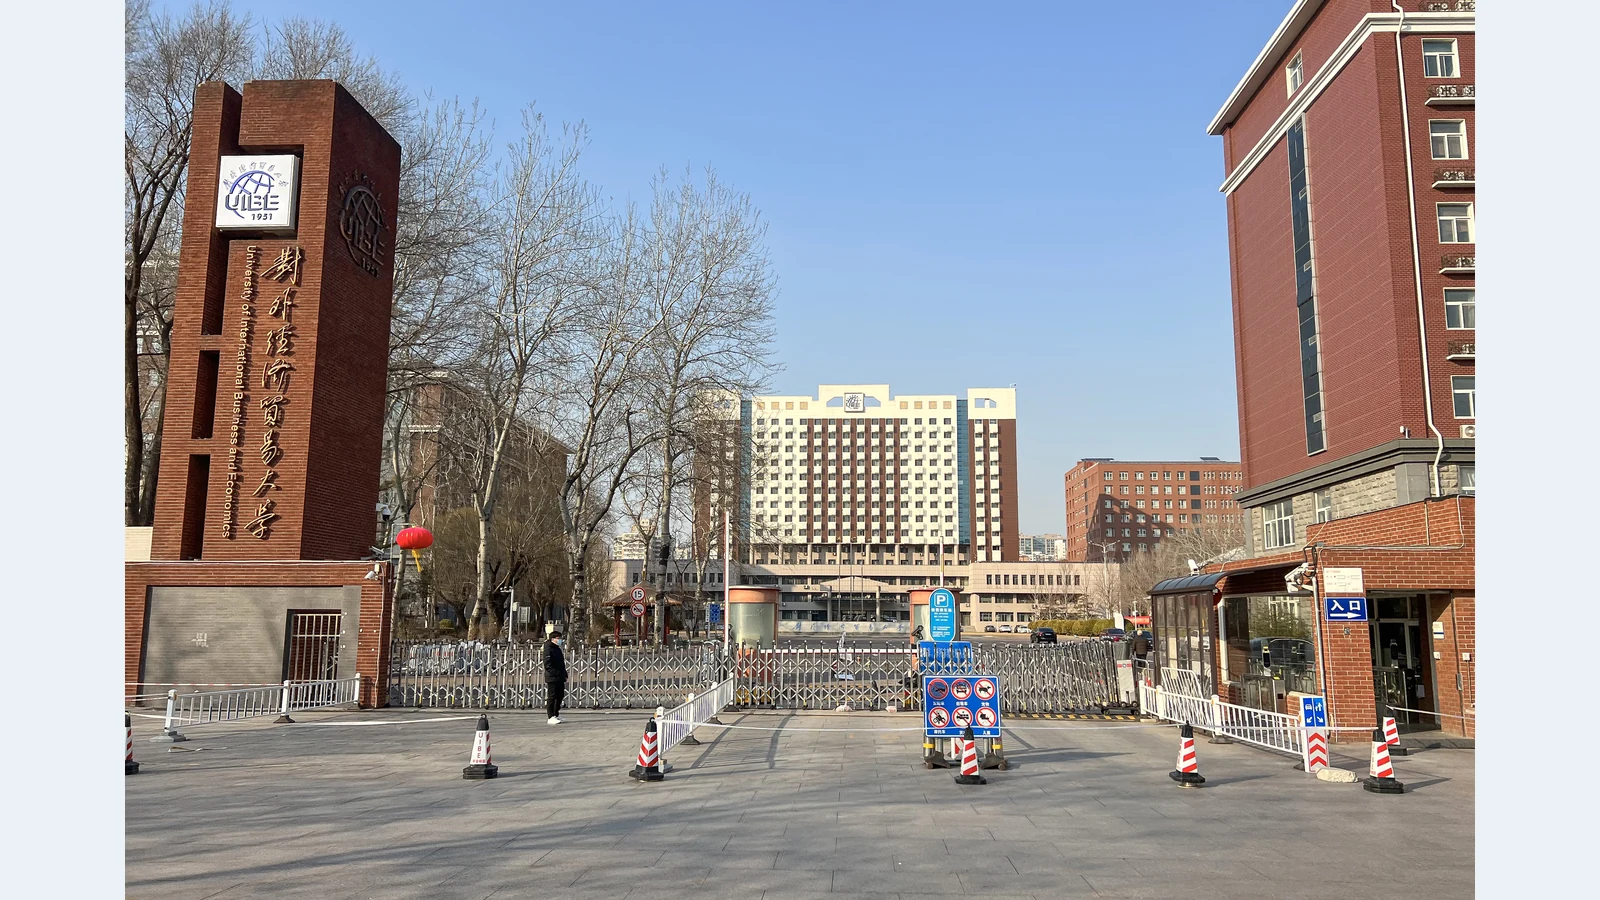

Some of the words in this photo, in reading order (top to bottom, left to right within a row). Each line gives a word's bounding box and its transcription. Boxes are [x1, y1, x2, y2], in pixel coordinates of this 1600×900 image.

[241, 245, 257, 301] University
[241, 303, 251, 315] of
[234, 317, 251, 389] International
[229, 391, 244, 445] Business
[227, 448, 237, 470] and
[222, 472, 237, 538] Economics
[634, 590, 643, 598] 15
[936, 595, 946, 605] P
[1330, 600, 1361, 611] 入口
